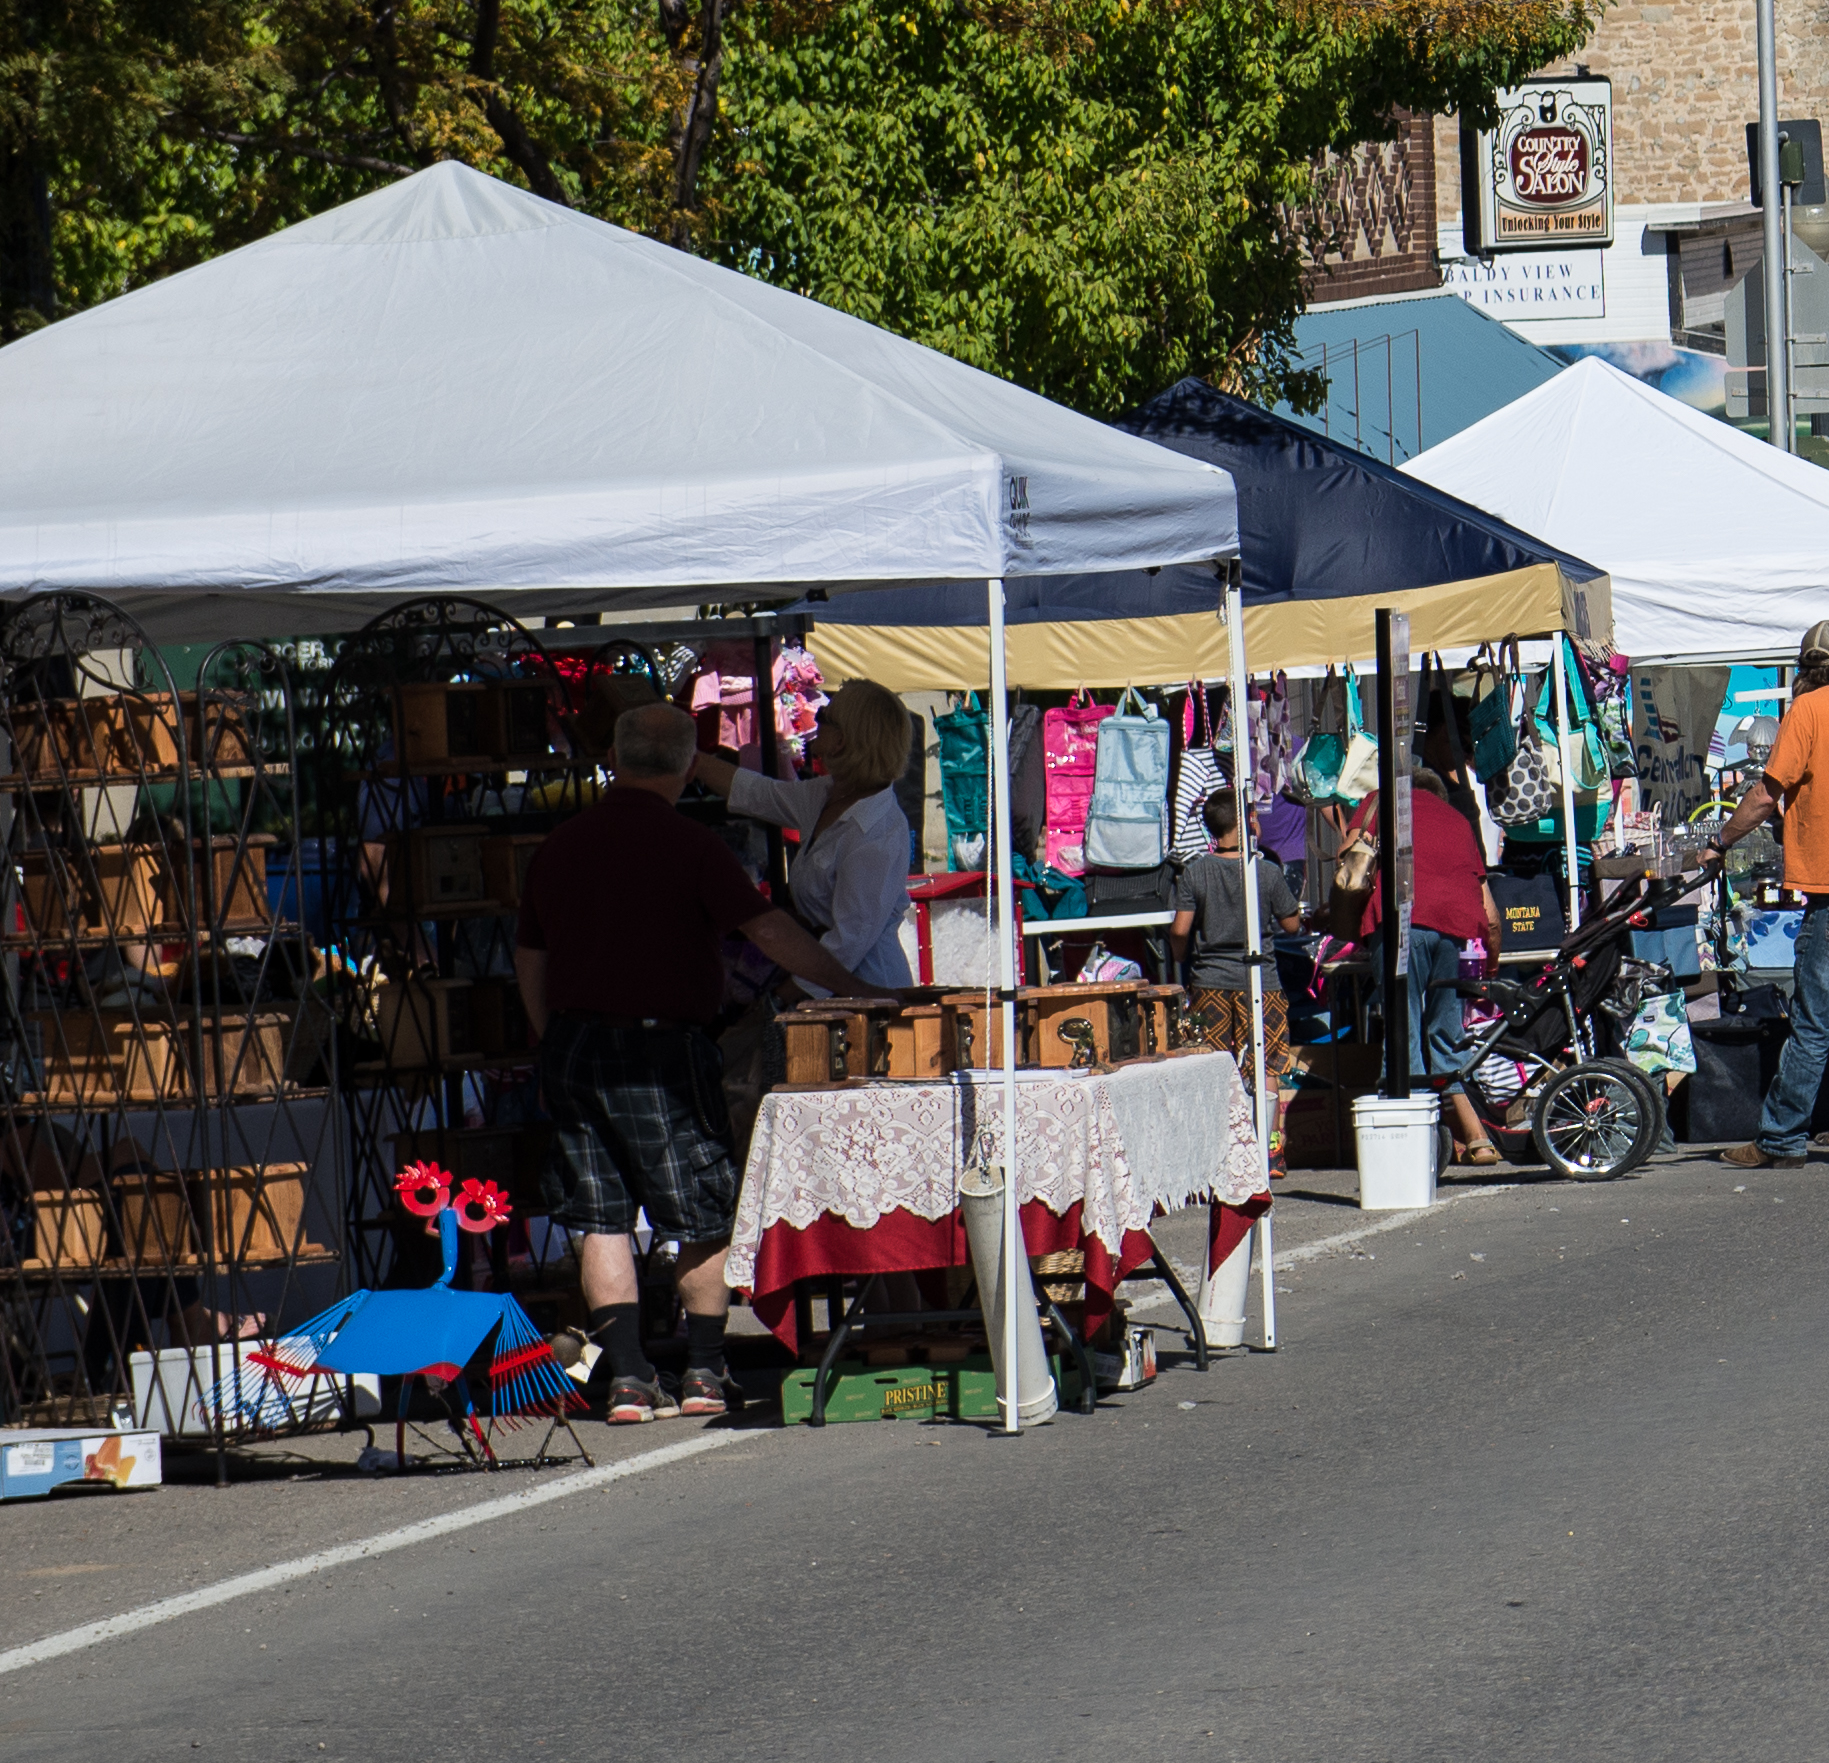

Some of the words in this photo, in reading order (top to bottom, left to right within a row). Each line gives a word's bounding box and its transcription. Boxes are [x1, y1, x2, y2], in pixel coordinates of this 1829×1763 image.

[1534, 149, 1580, 184] Style
[1502, 215, 1550, 232] Unlocking
[1553, 215, 1575, 230] Your
[1578, 213, 1601, 229] Style
[1445, 266, 1511, 282] BALDY
[1522, 263, 1574, 280] VIEW
[1484, 285, 1601, 304] INSURANCE
[1505, 906, 1541, 919] MONTANA
[1512, 921, 1535, 932] STATE
[885, 1382, 947, 1406] PRISTINE
